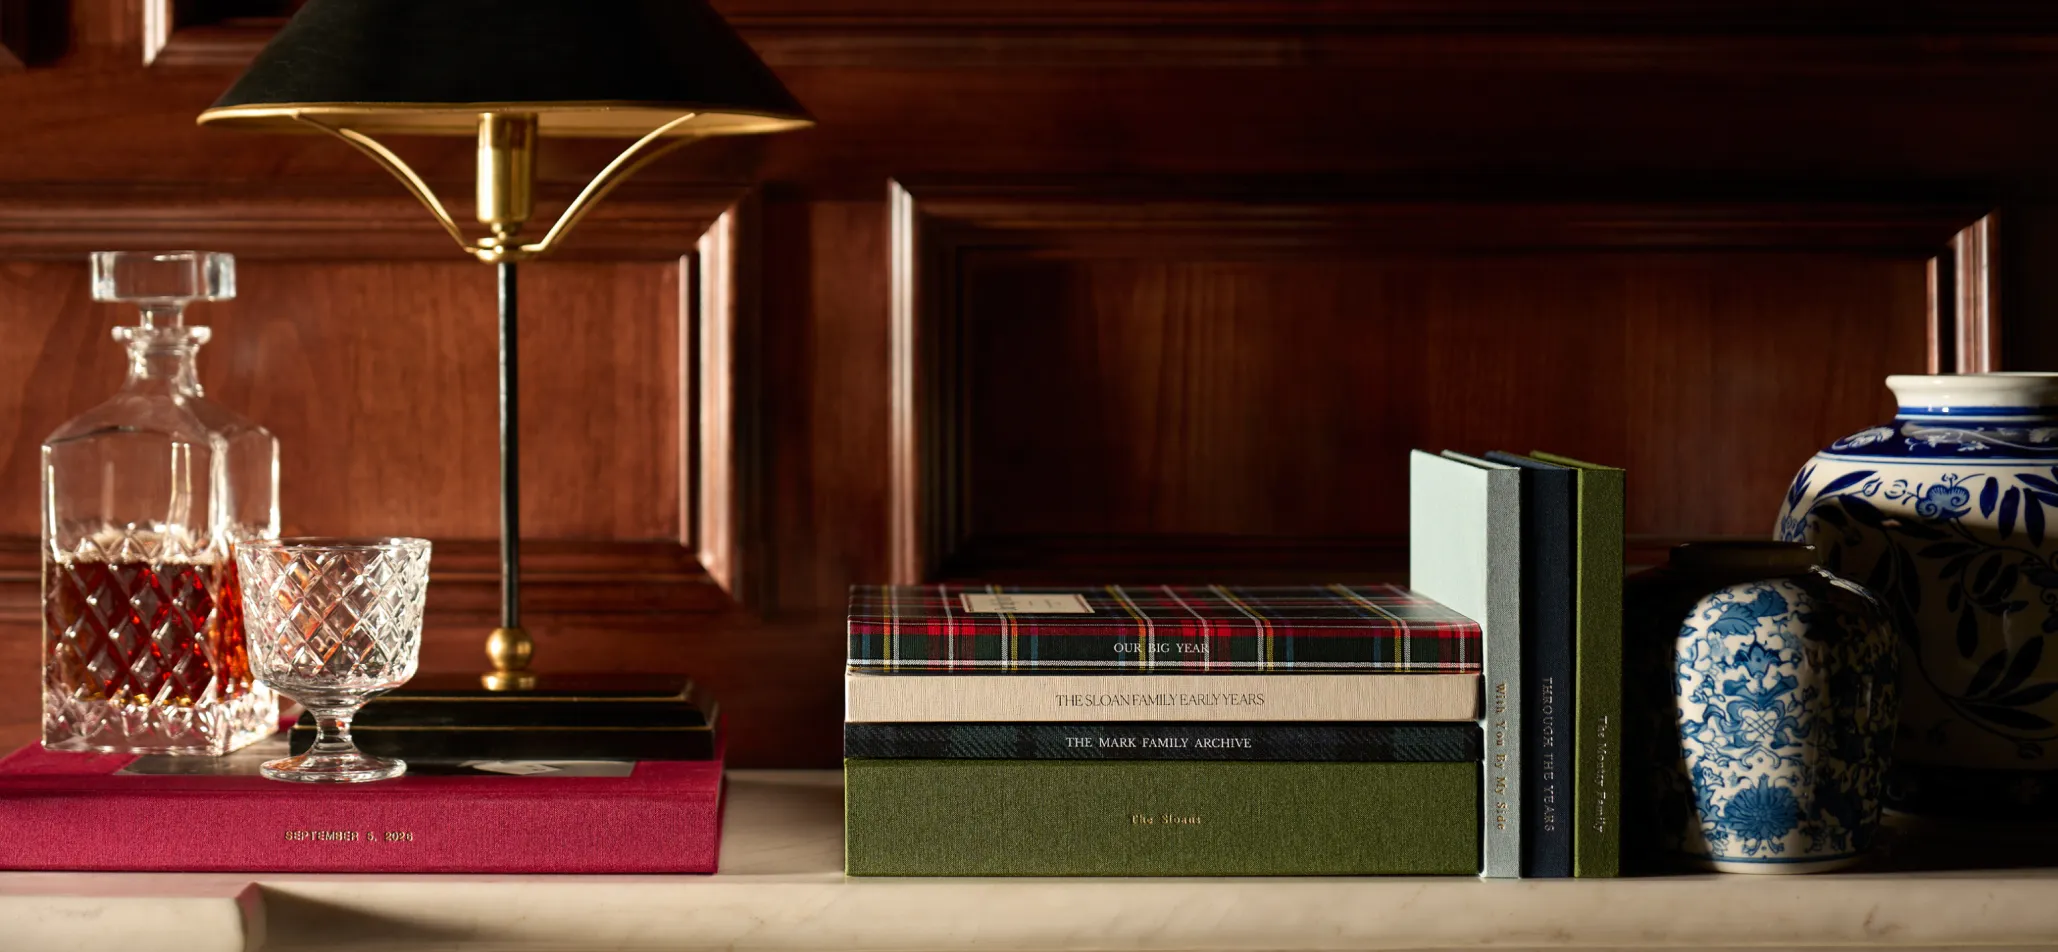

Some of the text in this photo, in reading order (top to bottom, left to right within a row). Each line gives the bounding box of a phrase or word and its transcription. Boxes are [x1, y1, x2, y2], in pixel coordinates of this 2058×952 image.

[1113, 642, 1210, 654] OUR BIG YEAR
[1055, 693, 1265, 707] THE SLOAN FAMILY EARLY YEARS
[1065, 737, 1252, 749] THE MARK FAMILY ARCHIVE
[1494, 683, 1508, 831] With You By My Side
[1541, 676, 1555, 832] THROUGH THE YEARS
[284, 830, 413, 843] SEPTEMBER 5, 2026
